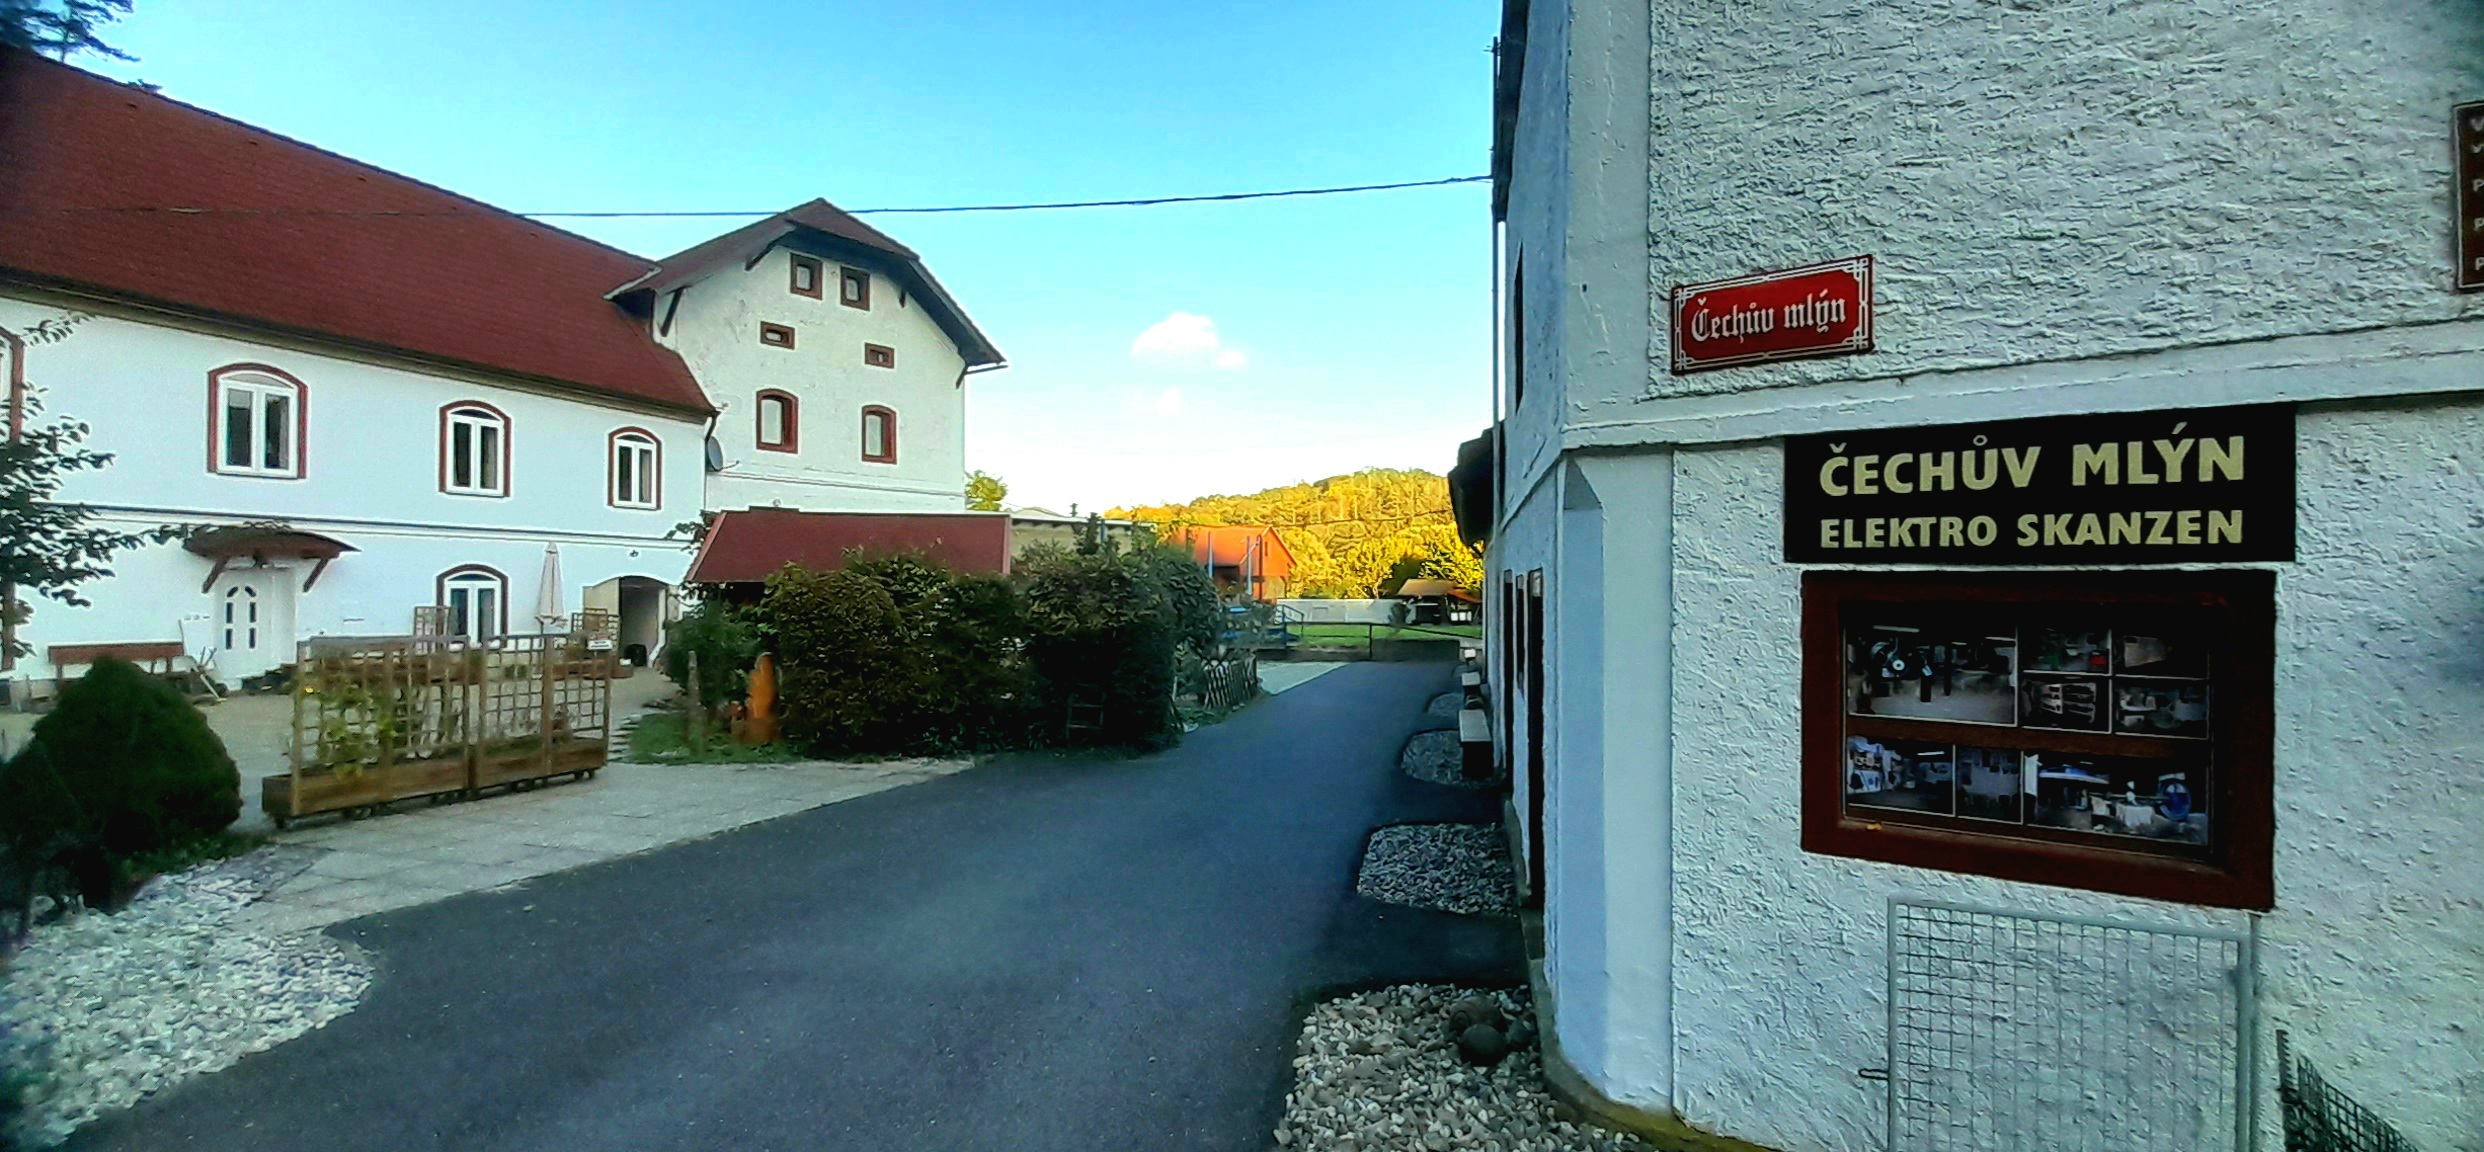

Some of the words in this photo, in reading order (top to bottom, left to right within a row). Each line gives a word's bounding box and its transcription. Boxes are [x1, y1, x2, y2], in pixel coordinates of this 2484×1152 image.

[1691, 297, 1775, 343] Čechův
[1783, 289, 1847, 333] mlýn
[1819, 434, 2042, 496] ČECHŮV
[2072, 421, 2245, 487] MLÝN
[1820, 516, 1998, 549] ELEKTRO
[2016, 509, 2243, 547] SKANZEN
